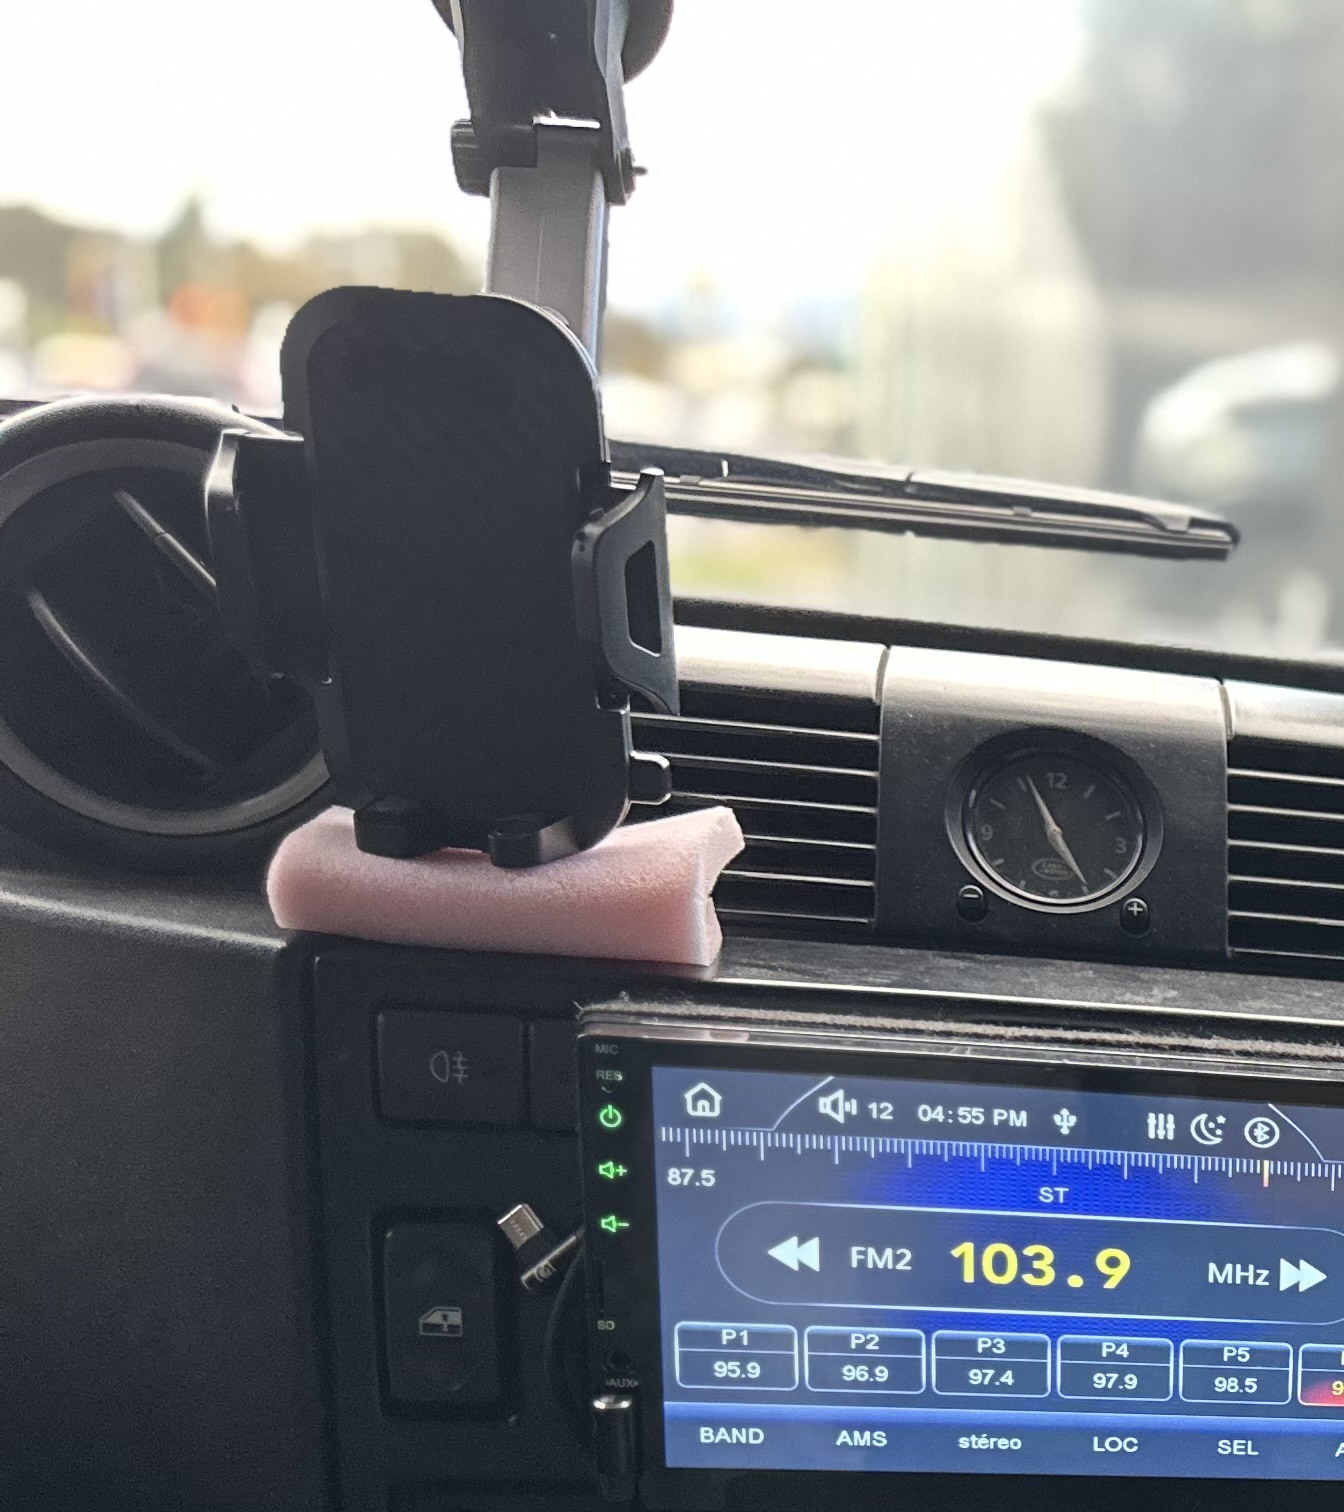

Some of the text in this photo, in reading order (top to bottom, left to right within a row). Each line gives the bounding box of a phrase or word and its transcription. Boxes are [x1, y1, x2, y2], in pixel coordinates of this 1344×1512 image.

[1046, 772, 1068, 789] 12
[980, 824, 994, 841] 9
[1114, 837, 1127, 854] 3
[595, 1043, 619, 1055] MIC
[595, 1069, 623, 1081] RES
[867, 1102, 1028, 1128] 12 04:55 PM
[667, 1167, 717, 1187] 87.5
[1038, 1186, 1070, 1204] ST
[850, 1240, 1270, 1290] FM2 103.9 MHz
[597, 1320, 615, 1331] SD
[721, 1328, 749, 1347] P1
[850, 1332, 880, 1351] P2
[977, 1337, 1006, 1355] P3
[1101, 1341, 1130, 1359] P4
[1222, 1346, 1251, 1363] P5
[713, 1360, 762, 1379] 95.9
[841, 1364, 890, 1384] 96.9
[967, 1368, 1015, 1387] 97.4
[1092, 1372, 1139, 1390] 97.9
[1213, 1376, 1258, 1394] 98.5
[699, 1426, 765, 1445] BAND
[835, 1429, 888, 1448] AMS
[958, 1432, 1023, 1451] stéreo
[1092, 1435, 1140, 1453] LOC
[1217, 1439, 1260, 1457] SEL
